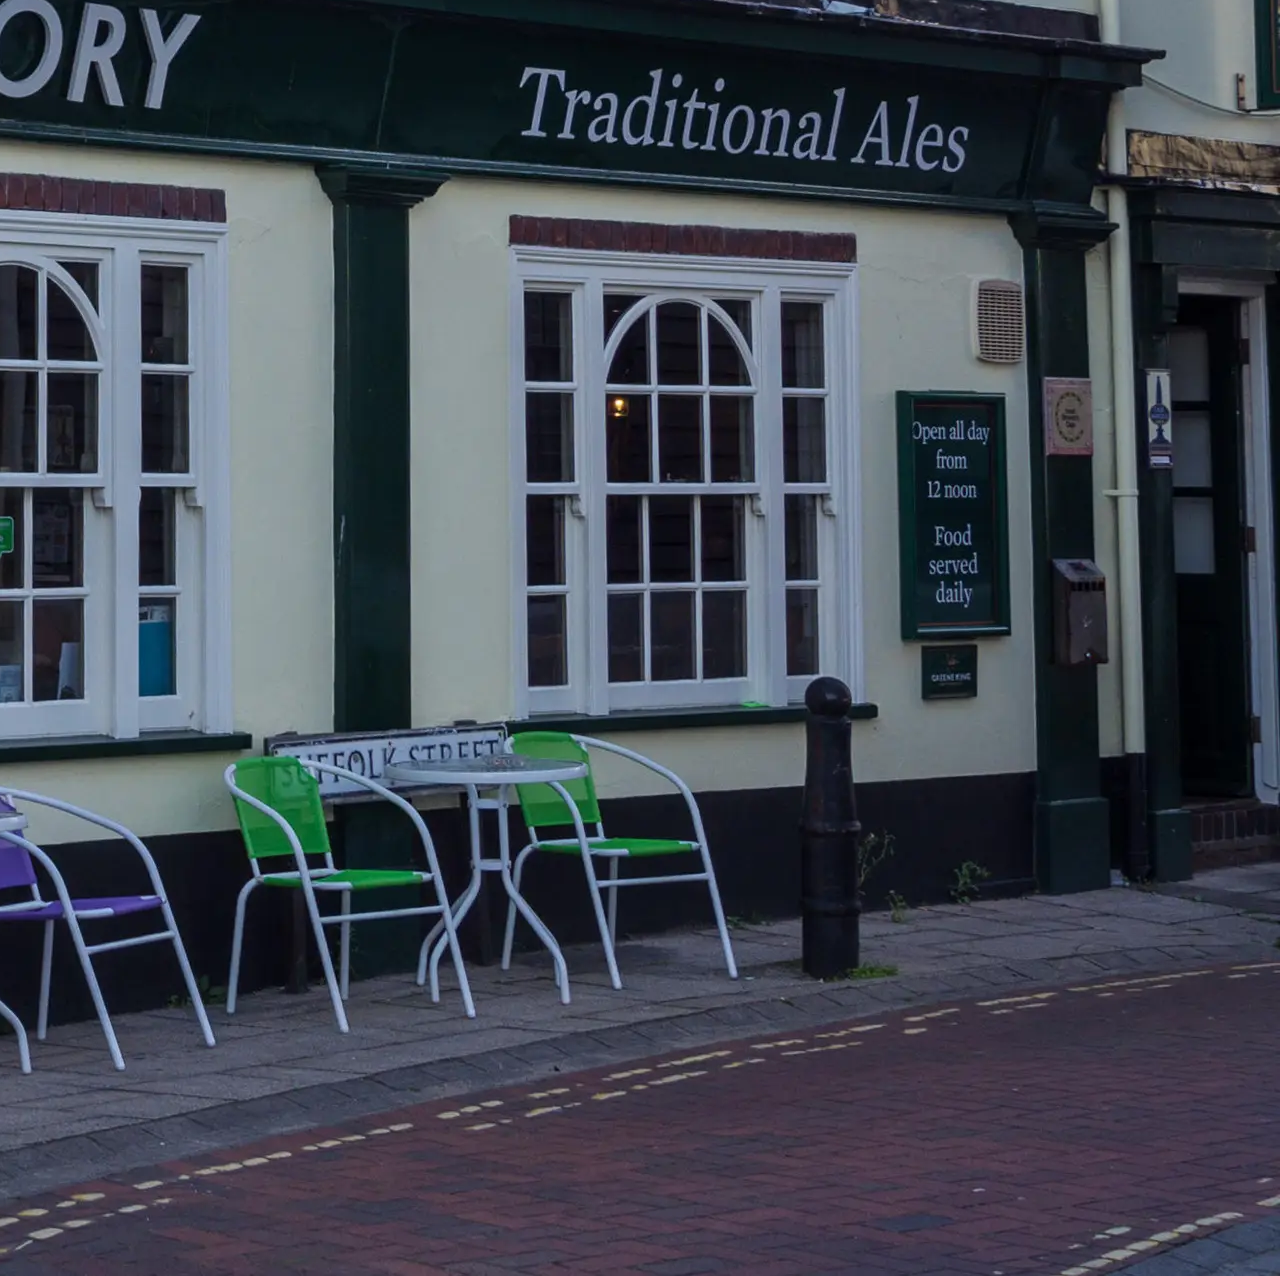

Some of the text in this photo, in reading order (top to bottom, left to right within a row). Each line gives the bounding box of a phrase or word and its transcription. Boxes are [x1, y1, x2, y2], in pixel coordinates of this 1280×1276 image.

[519, 66, 970, 173] Traditional Ales
[912, 421, 990, 445] Open all day
[936, 449, 967, 469] from
[927, 481, 977, 498] 12 noon
[934, 525, 972, 546] Food
[929, 553, 978, 574] served
[936, 581, 973, 608] daily
